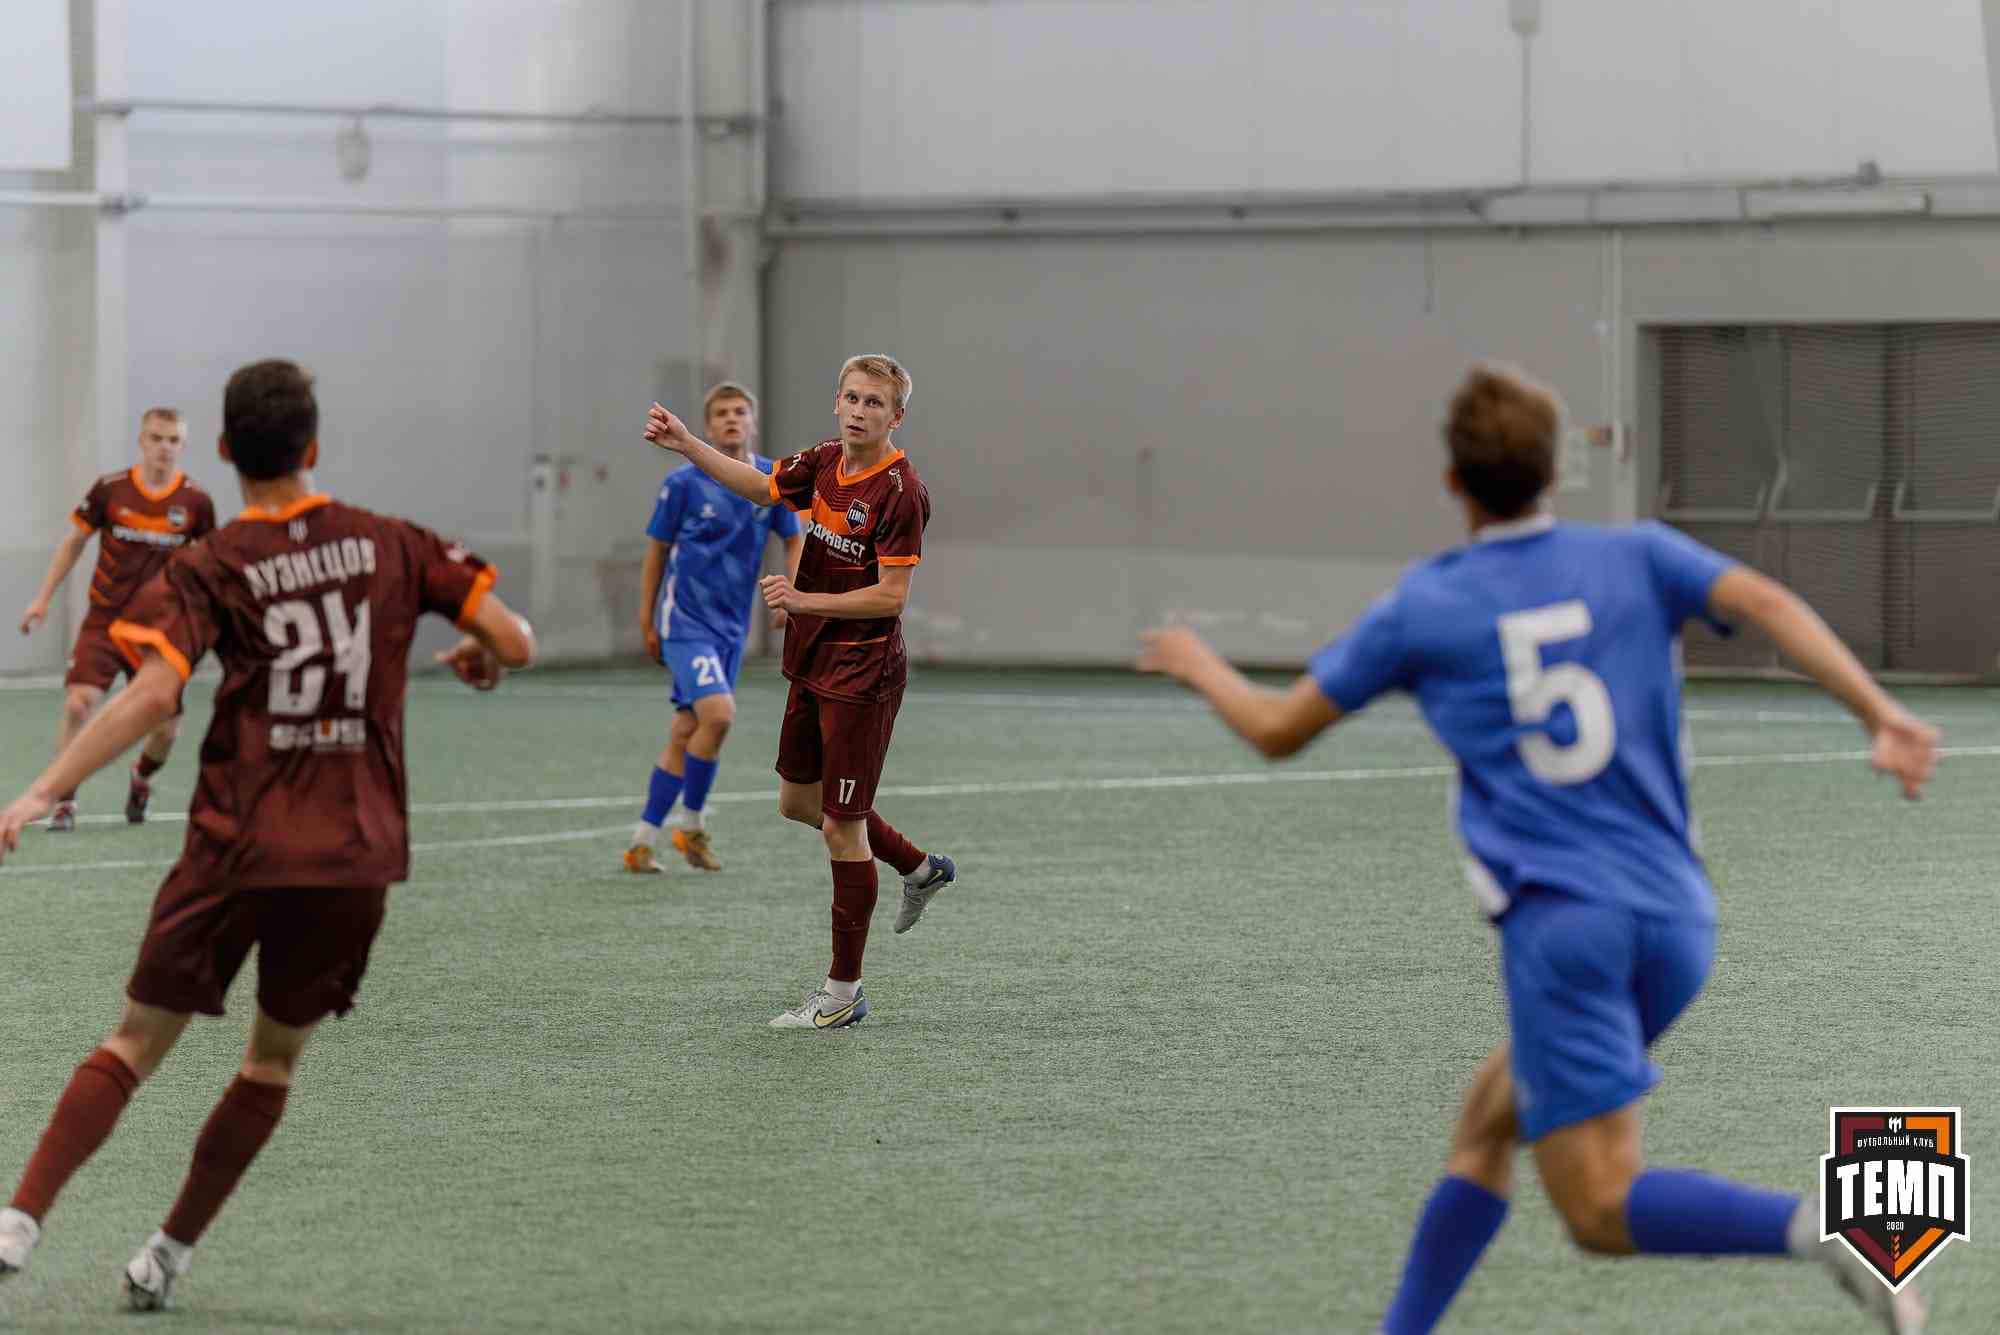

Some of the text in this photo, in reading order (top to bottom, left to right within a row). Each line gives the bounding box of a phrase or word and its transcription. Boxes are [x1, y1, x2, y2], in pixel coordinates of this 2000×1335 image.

[263, 590, 371, 716] 24
[692, 655, 725, 687] 21
[1497, 598, 1617, 786] 5
[838, 778, 857, 805] 17
